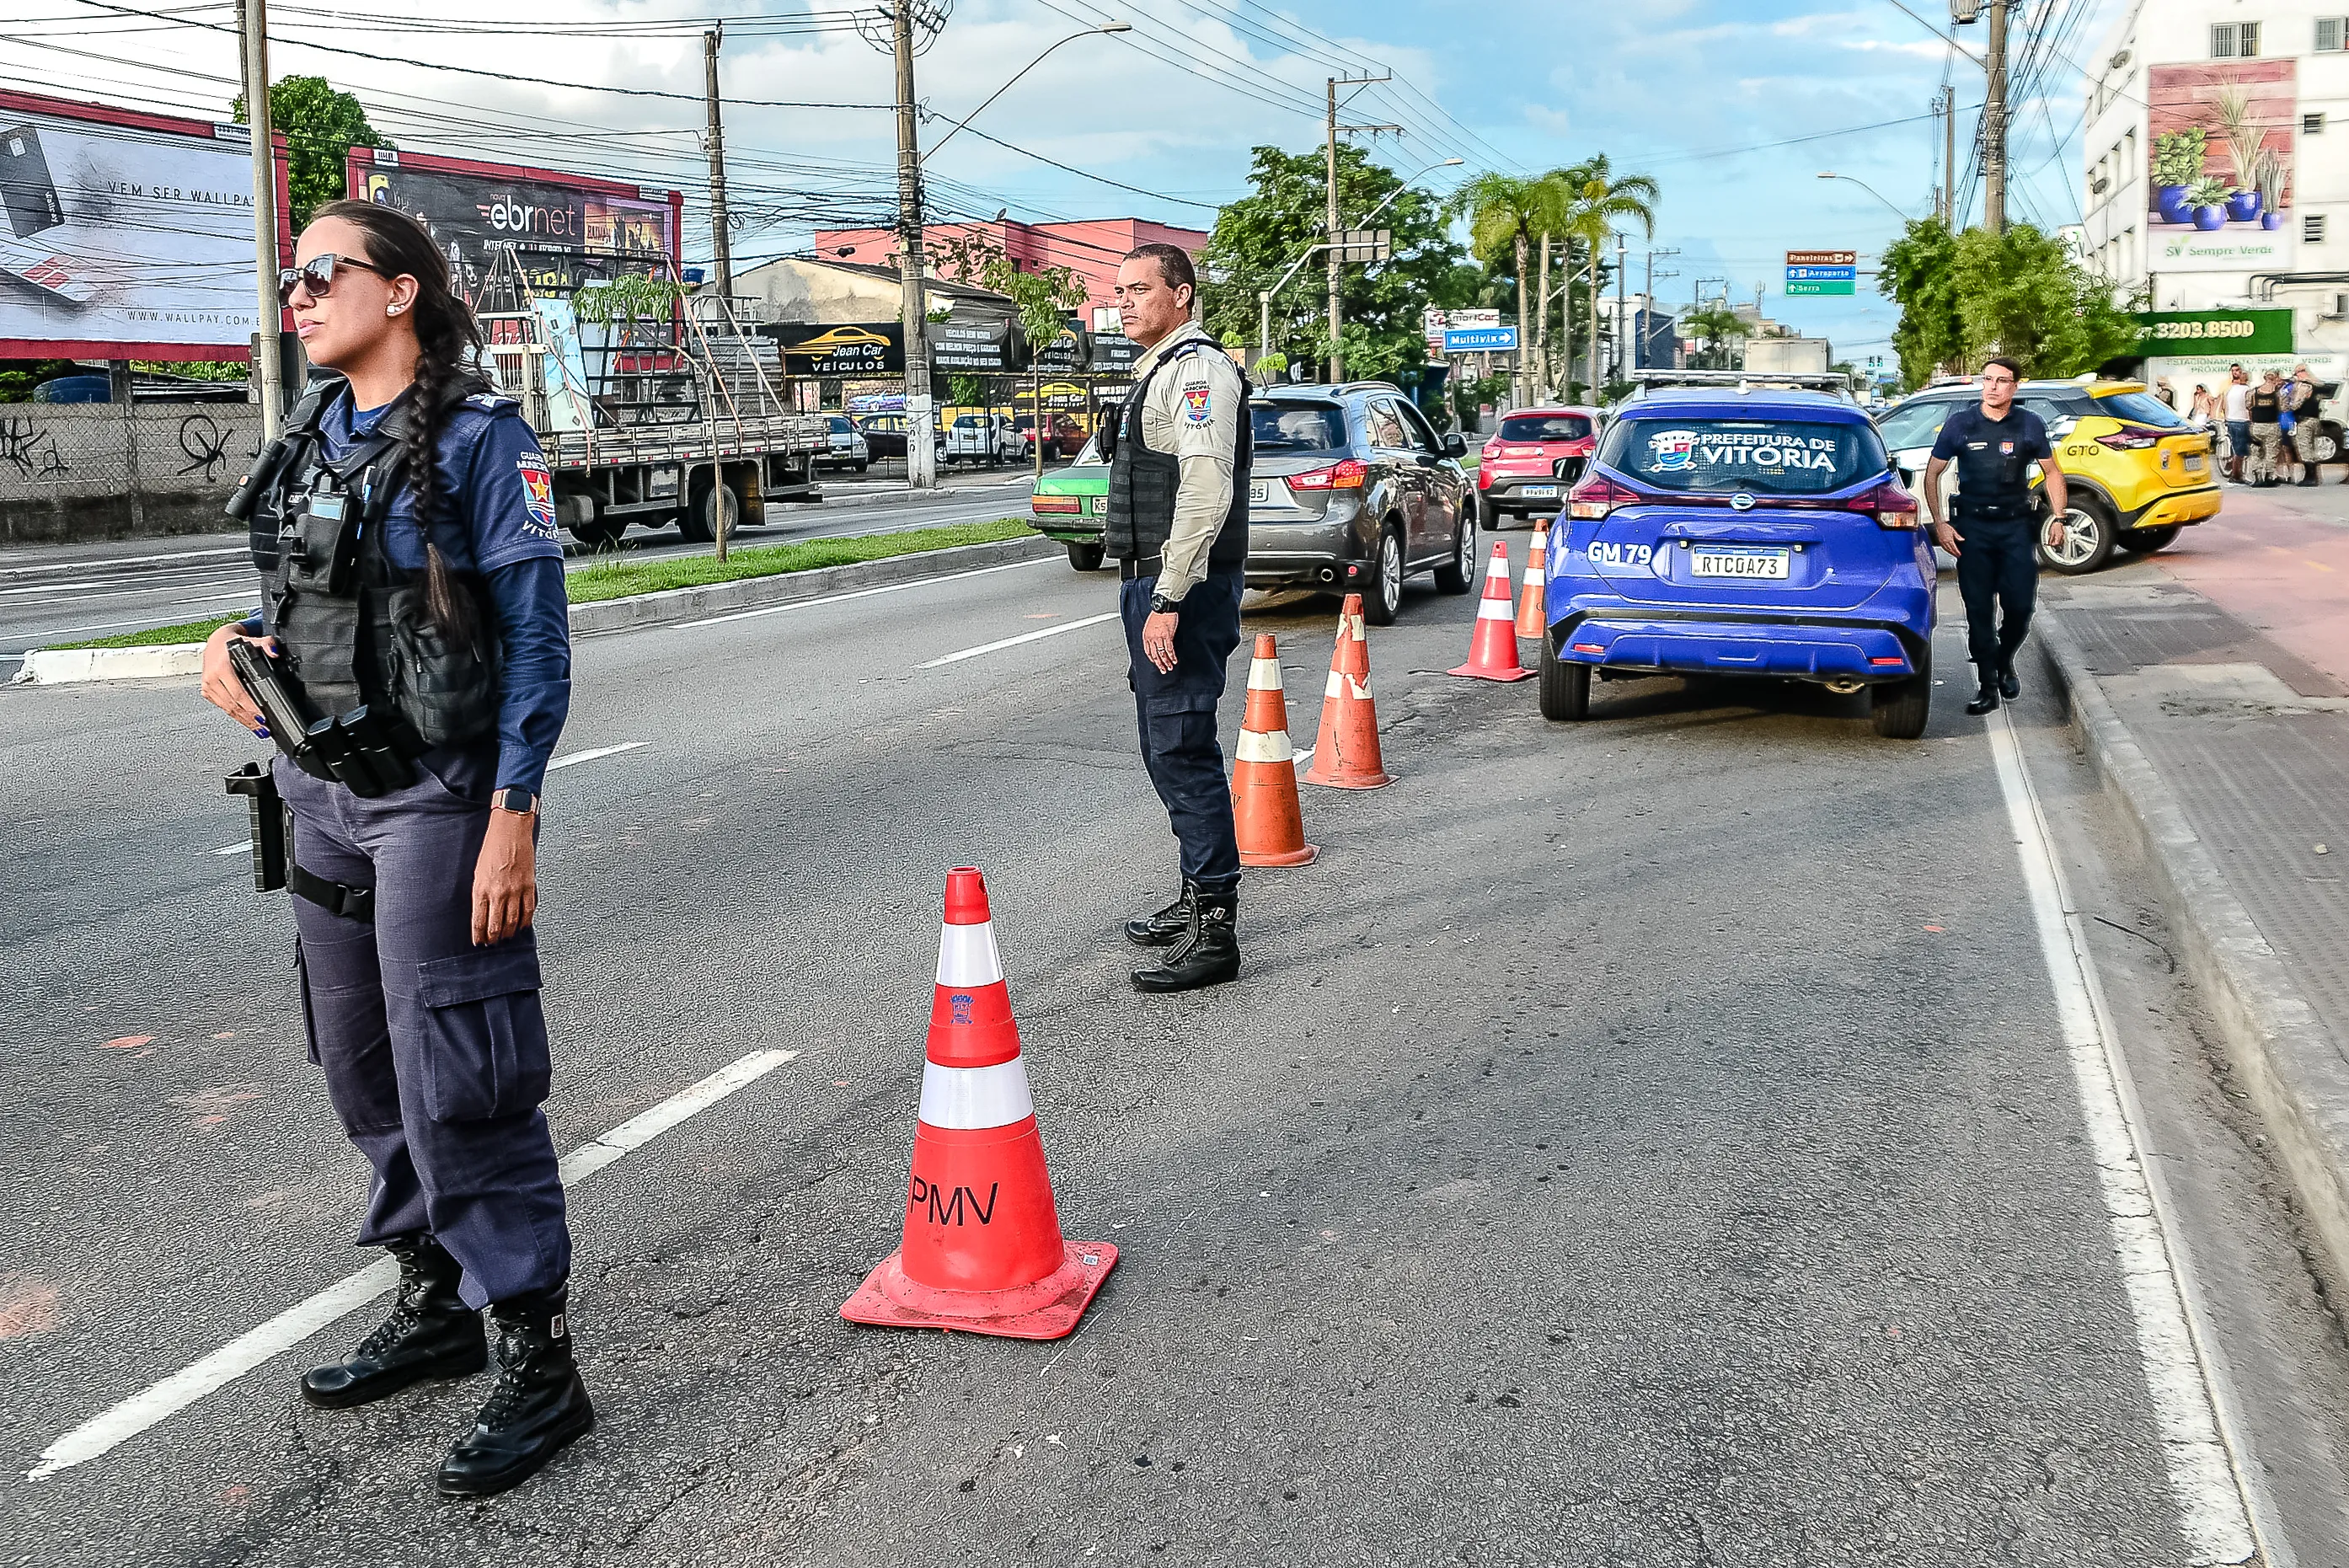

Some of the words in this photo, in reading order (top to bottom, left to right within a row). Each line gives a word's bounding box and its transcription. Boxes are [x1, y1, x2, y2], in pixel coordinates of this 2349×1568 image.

[107, 180, 142, 197] VEM
[152, 186, 181, 200] SER
[490, 194, 575, 235] ebrnet
[1450, 334, 1498, 345] Multivix
[832, 345, 859, 356] Jean
[862, 344, 883, 356] Car
[812, 361, 885, 371] VEÍCULOS
[1701, 432, 1806, 448] PREFEITURA
[1808, 437, 1836, 452] DE
[2067, 445, 2100, 456] GTO
[1700, 443, 1837, 473] VITÓRIA
[1587, 540, 1621, 564] GM
[1624, 543, 1652, 565] 79
[908, 1175, 998, 1227] PMV
